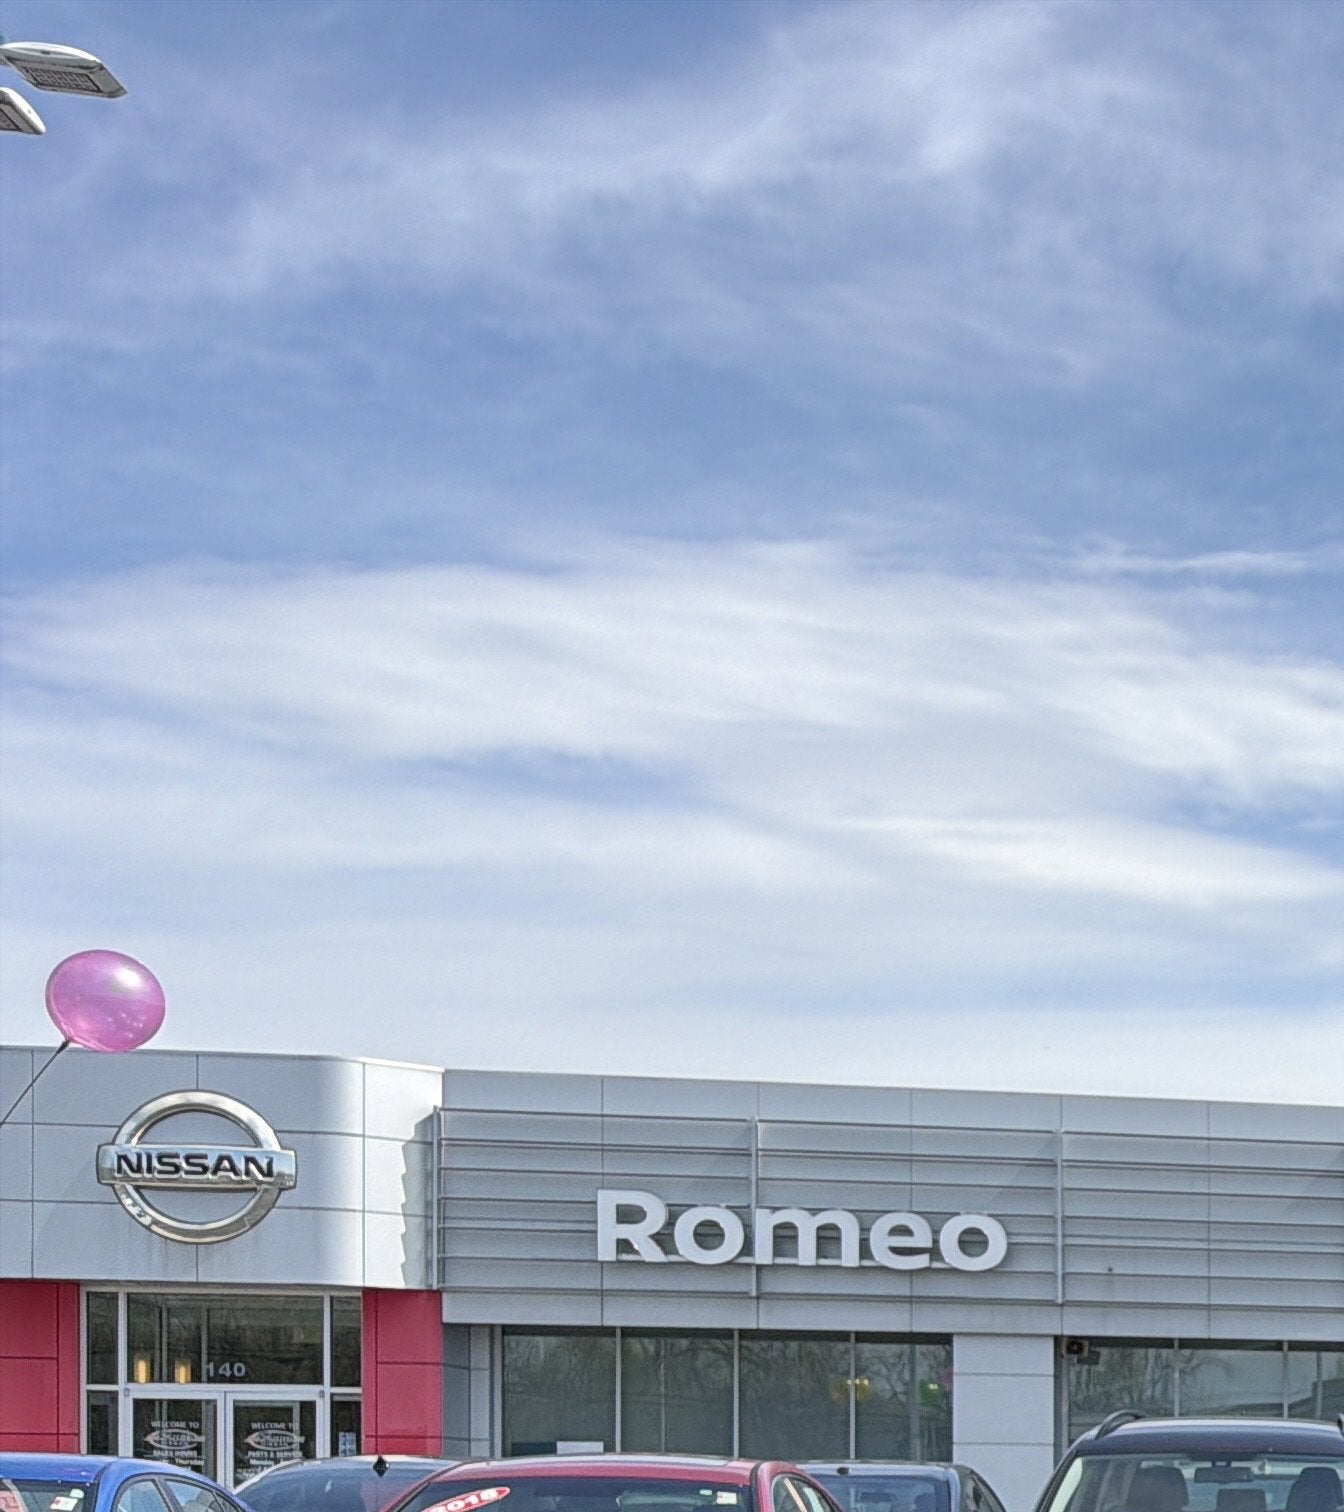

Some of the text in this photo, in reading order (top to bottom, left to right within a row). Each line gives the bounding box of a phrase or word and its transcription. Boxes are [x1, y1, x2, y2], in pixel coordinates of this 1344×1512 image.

[114, 1151, 274, 1181] NISSAN
[597, 1189, 1008, 1272] Romeo
[206, 1362, 247, 1377] 140
[188, 1421, 200, 1429] TO
